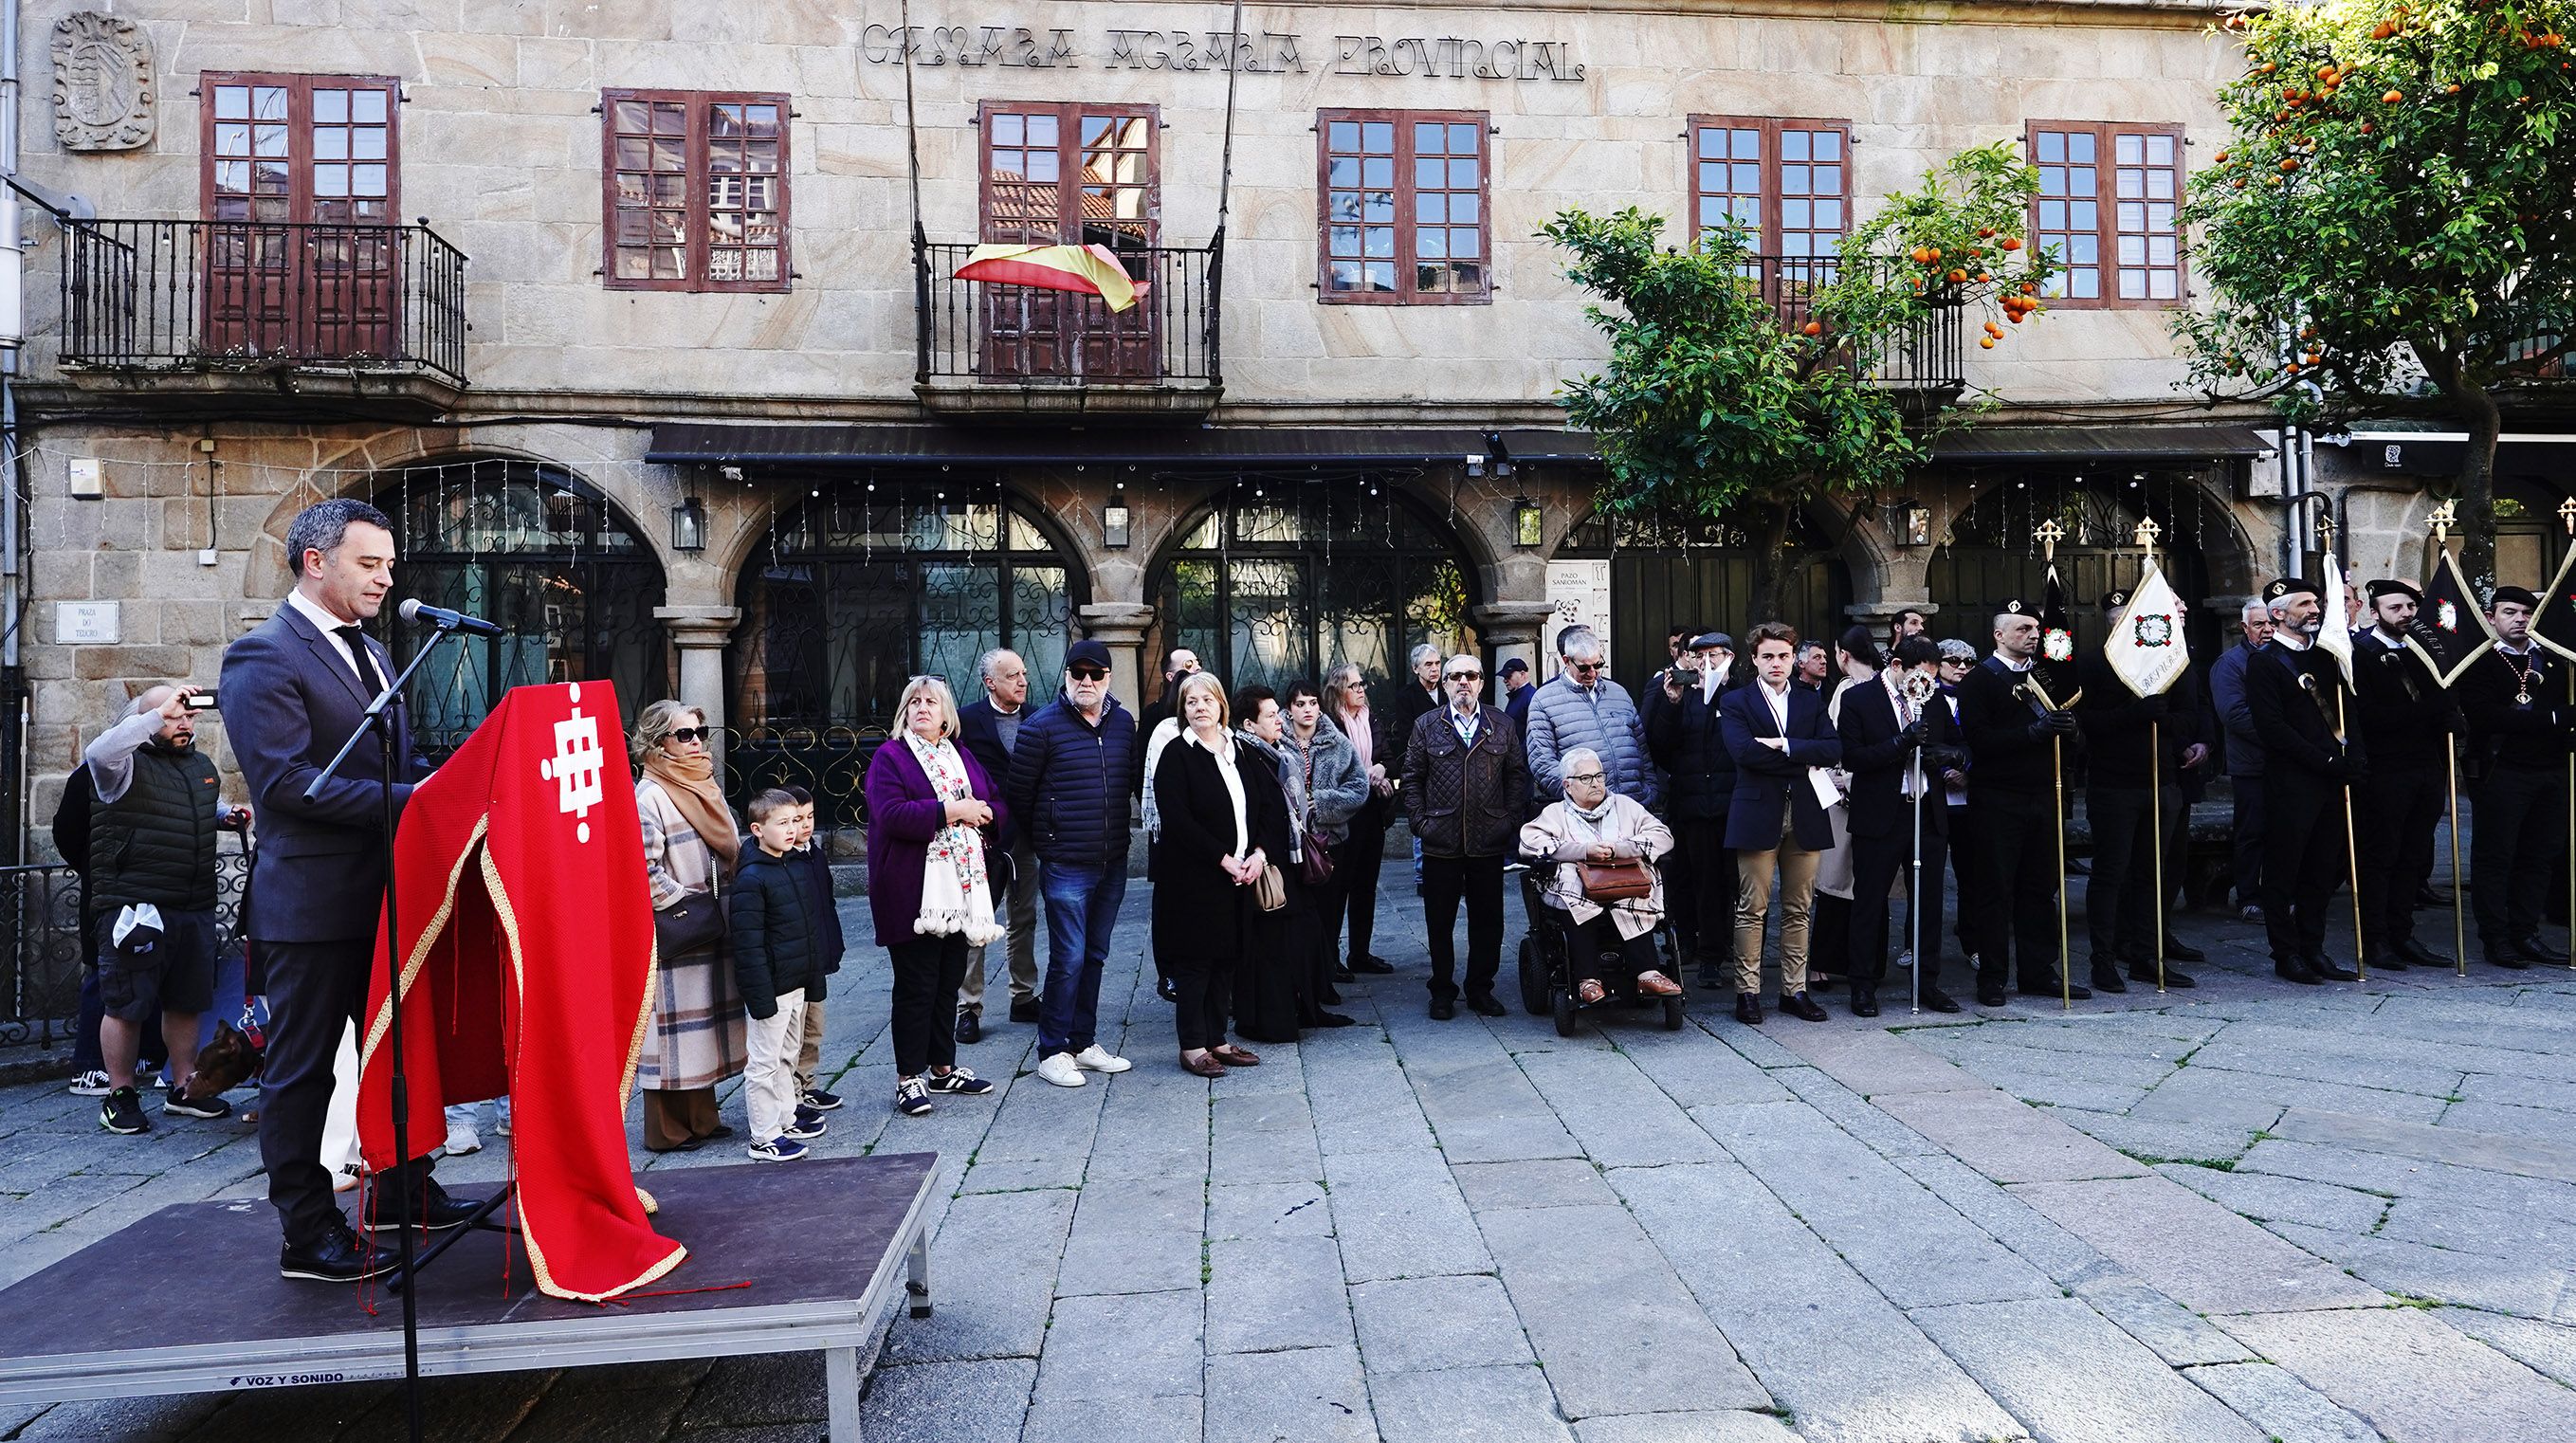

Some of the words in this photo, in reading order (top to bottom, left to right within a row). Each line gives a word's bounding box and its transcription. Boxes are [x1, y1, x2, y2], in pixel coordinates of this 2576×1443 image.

[1105, 28, 1308, 73] AGRARIA
[1334, 34, 1585, 82] PROVINCIAL
[78, 608, 97, 616] PRAZA
[82, 618, 92, 627] DO
[75, 630, 99, 638] TEUCRO
[246, 1376, 274, 1386] VOZ
[278, 1375, 288, 1385] Y
[290, 1373, 344, 1385] SONIDO
